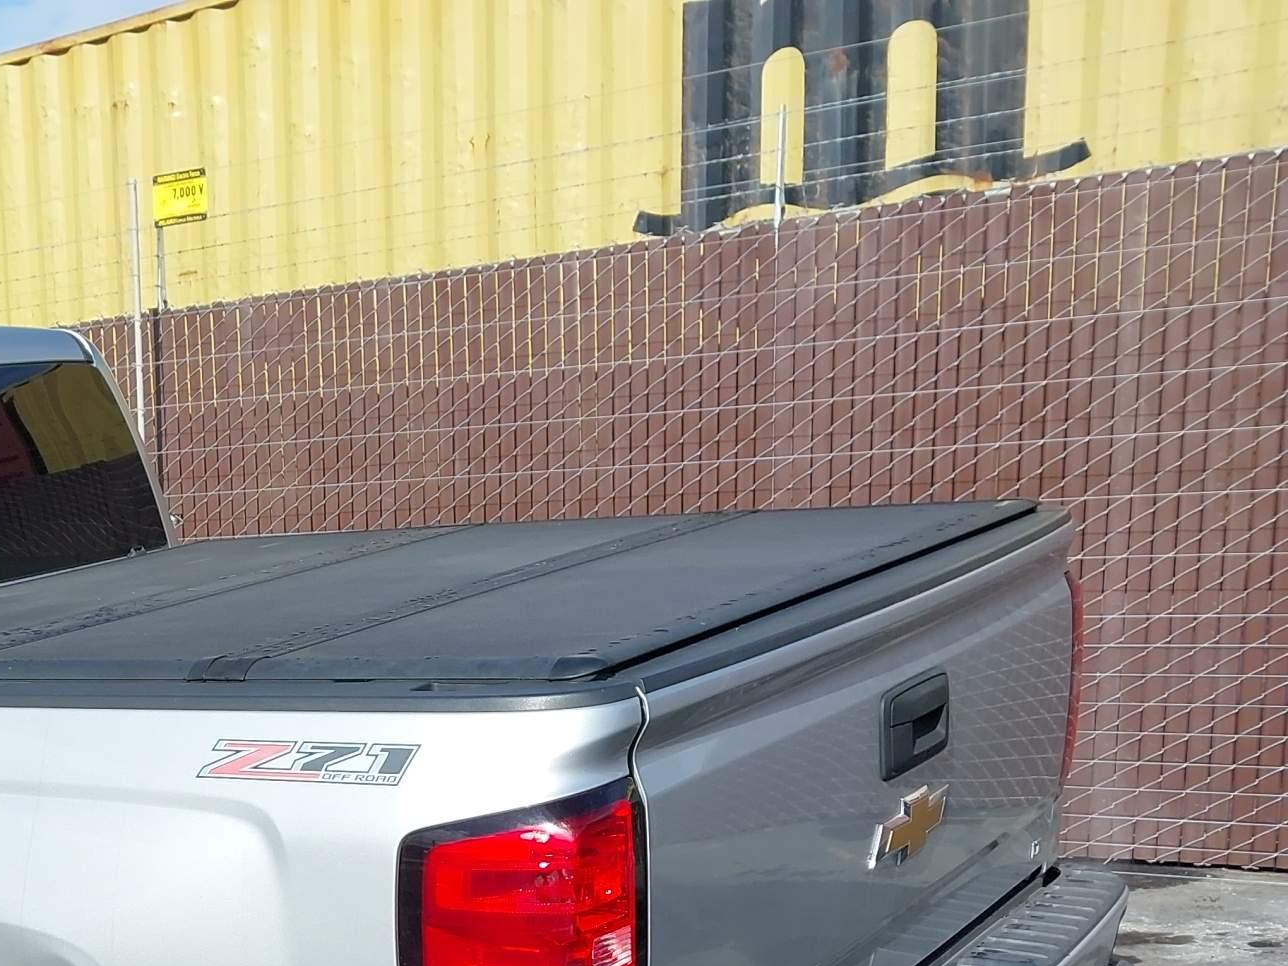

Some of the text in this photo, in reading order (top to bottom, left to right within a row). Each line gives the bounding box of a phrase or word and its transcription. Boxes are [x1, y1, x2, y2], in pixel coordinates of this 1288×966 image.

[196, 739, 422, 782] Z71
[321, 773, 398, 783] OFF ROAD
